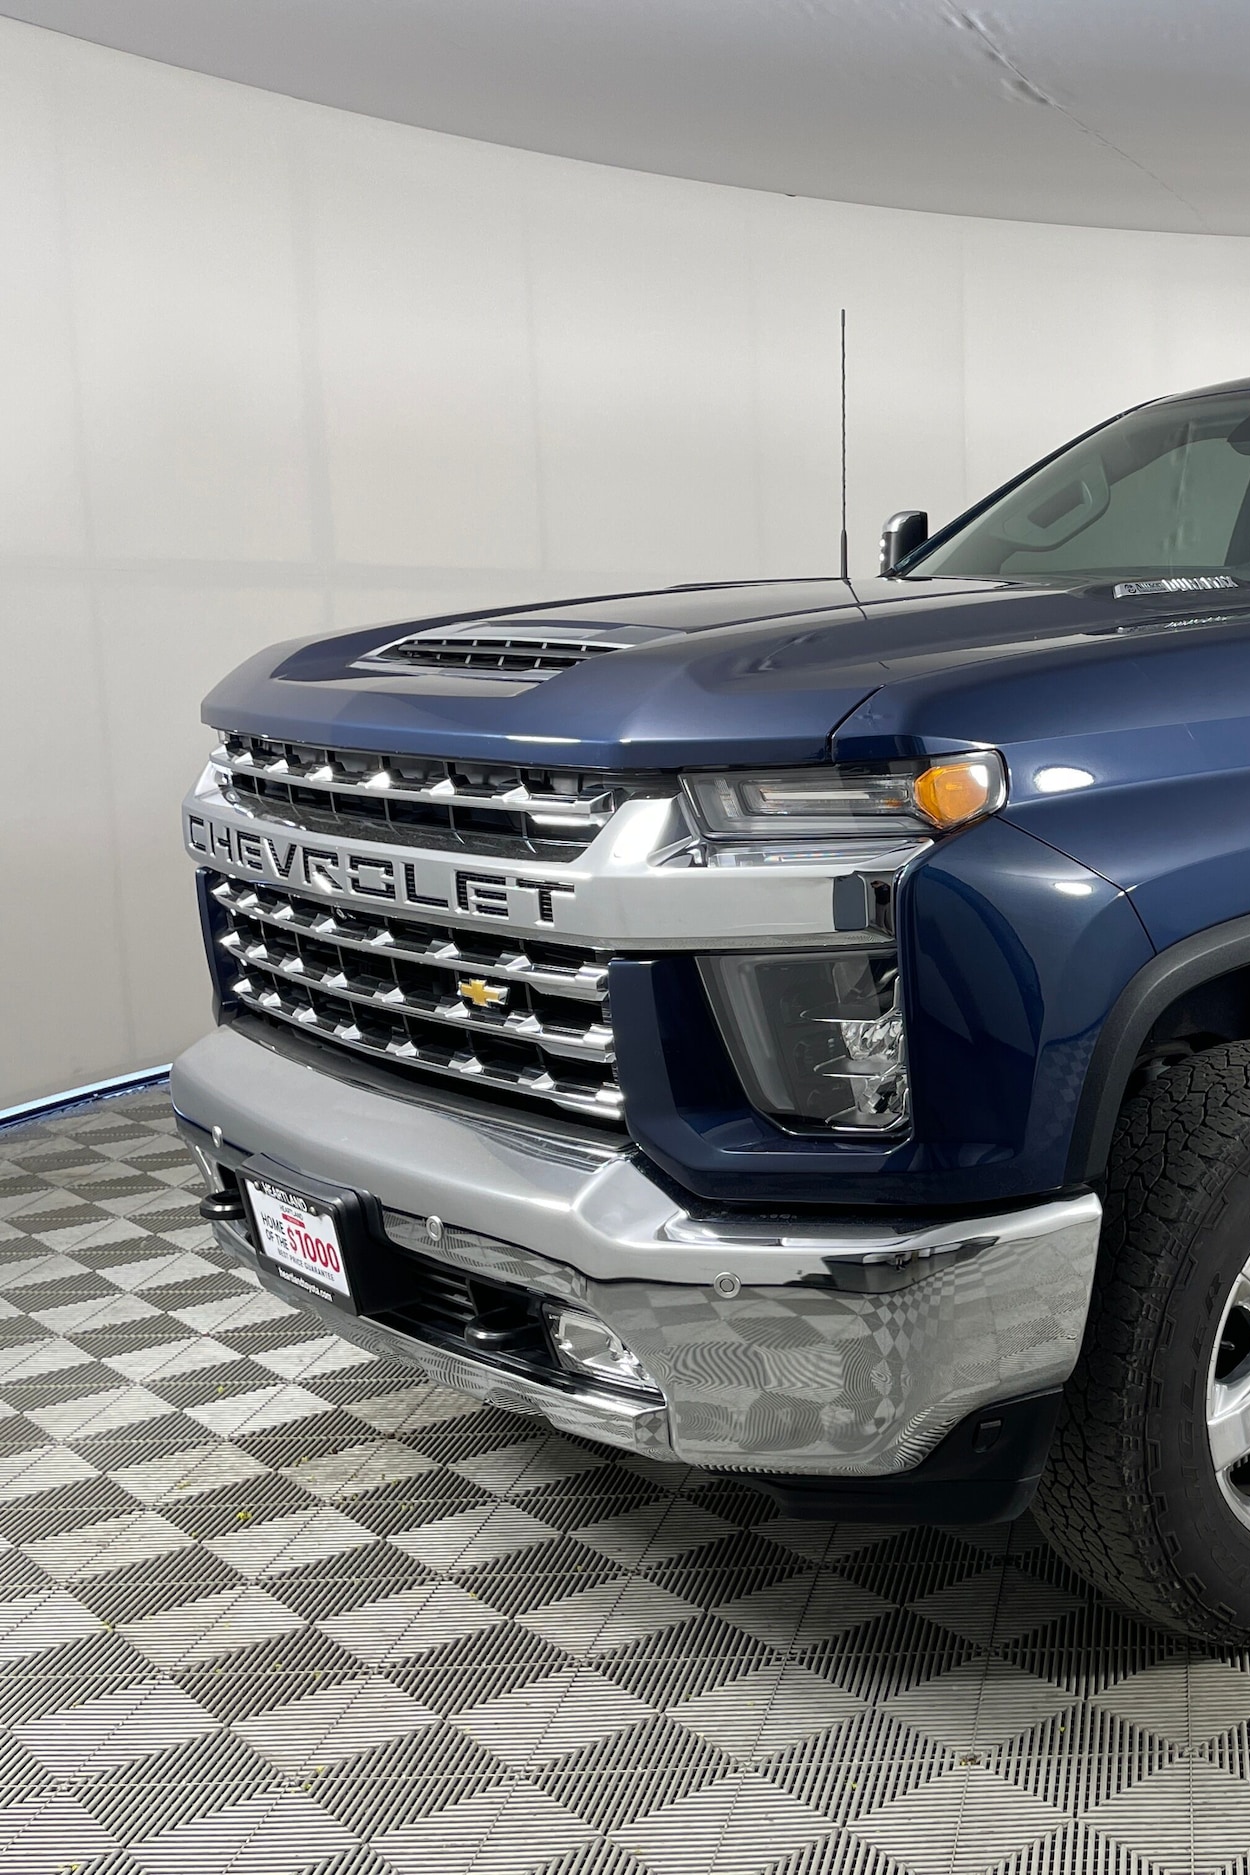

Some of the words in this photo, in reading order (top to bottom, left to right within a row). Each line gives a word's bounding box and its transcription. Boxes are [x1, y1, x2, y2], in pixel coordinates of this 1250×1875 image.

[187, 813, 577, 928] CHEVROLET
[261, 1180, 308, 1213] HEARTLAND
[260, 1211, 285, 1235] HOME
[265, 1228, 277, 1243] OF
[275, 1232, 289, 1251] THE
[287, 1225, 341, 1273] $1000
[289, 1253, 304, 1268] PRICE
[304, 1261, 335, 1282] GUARANTEE
